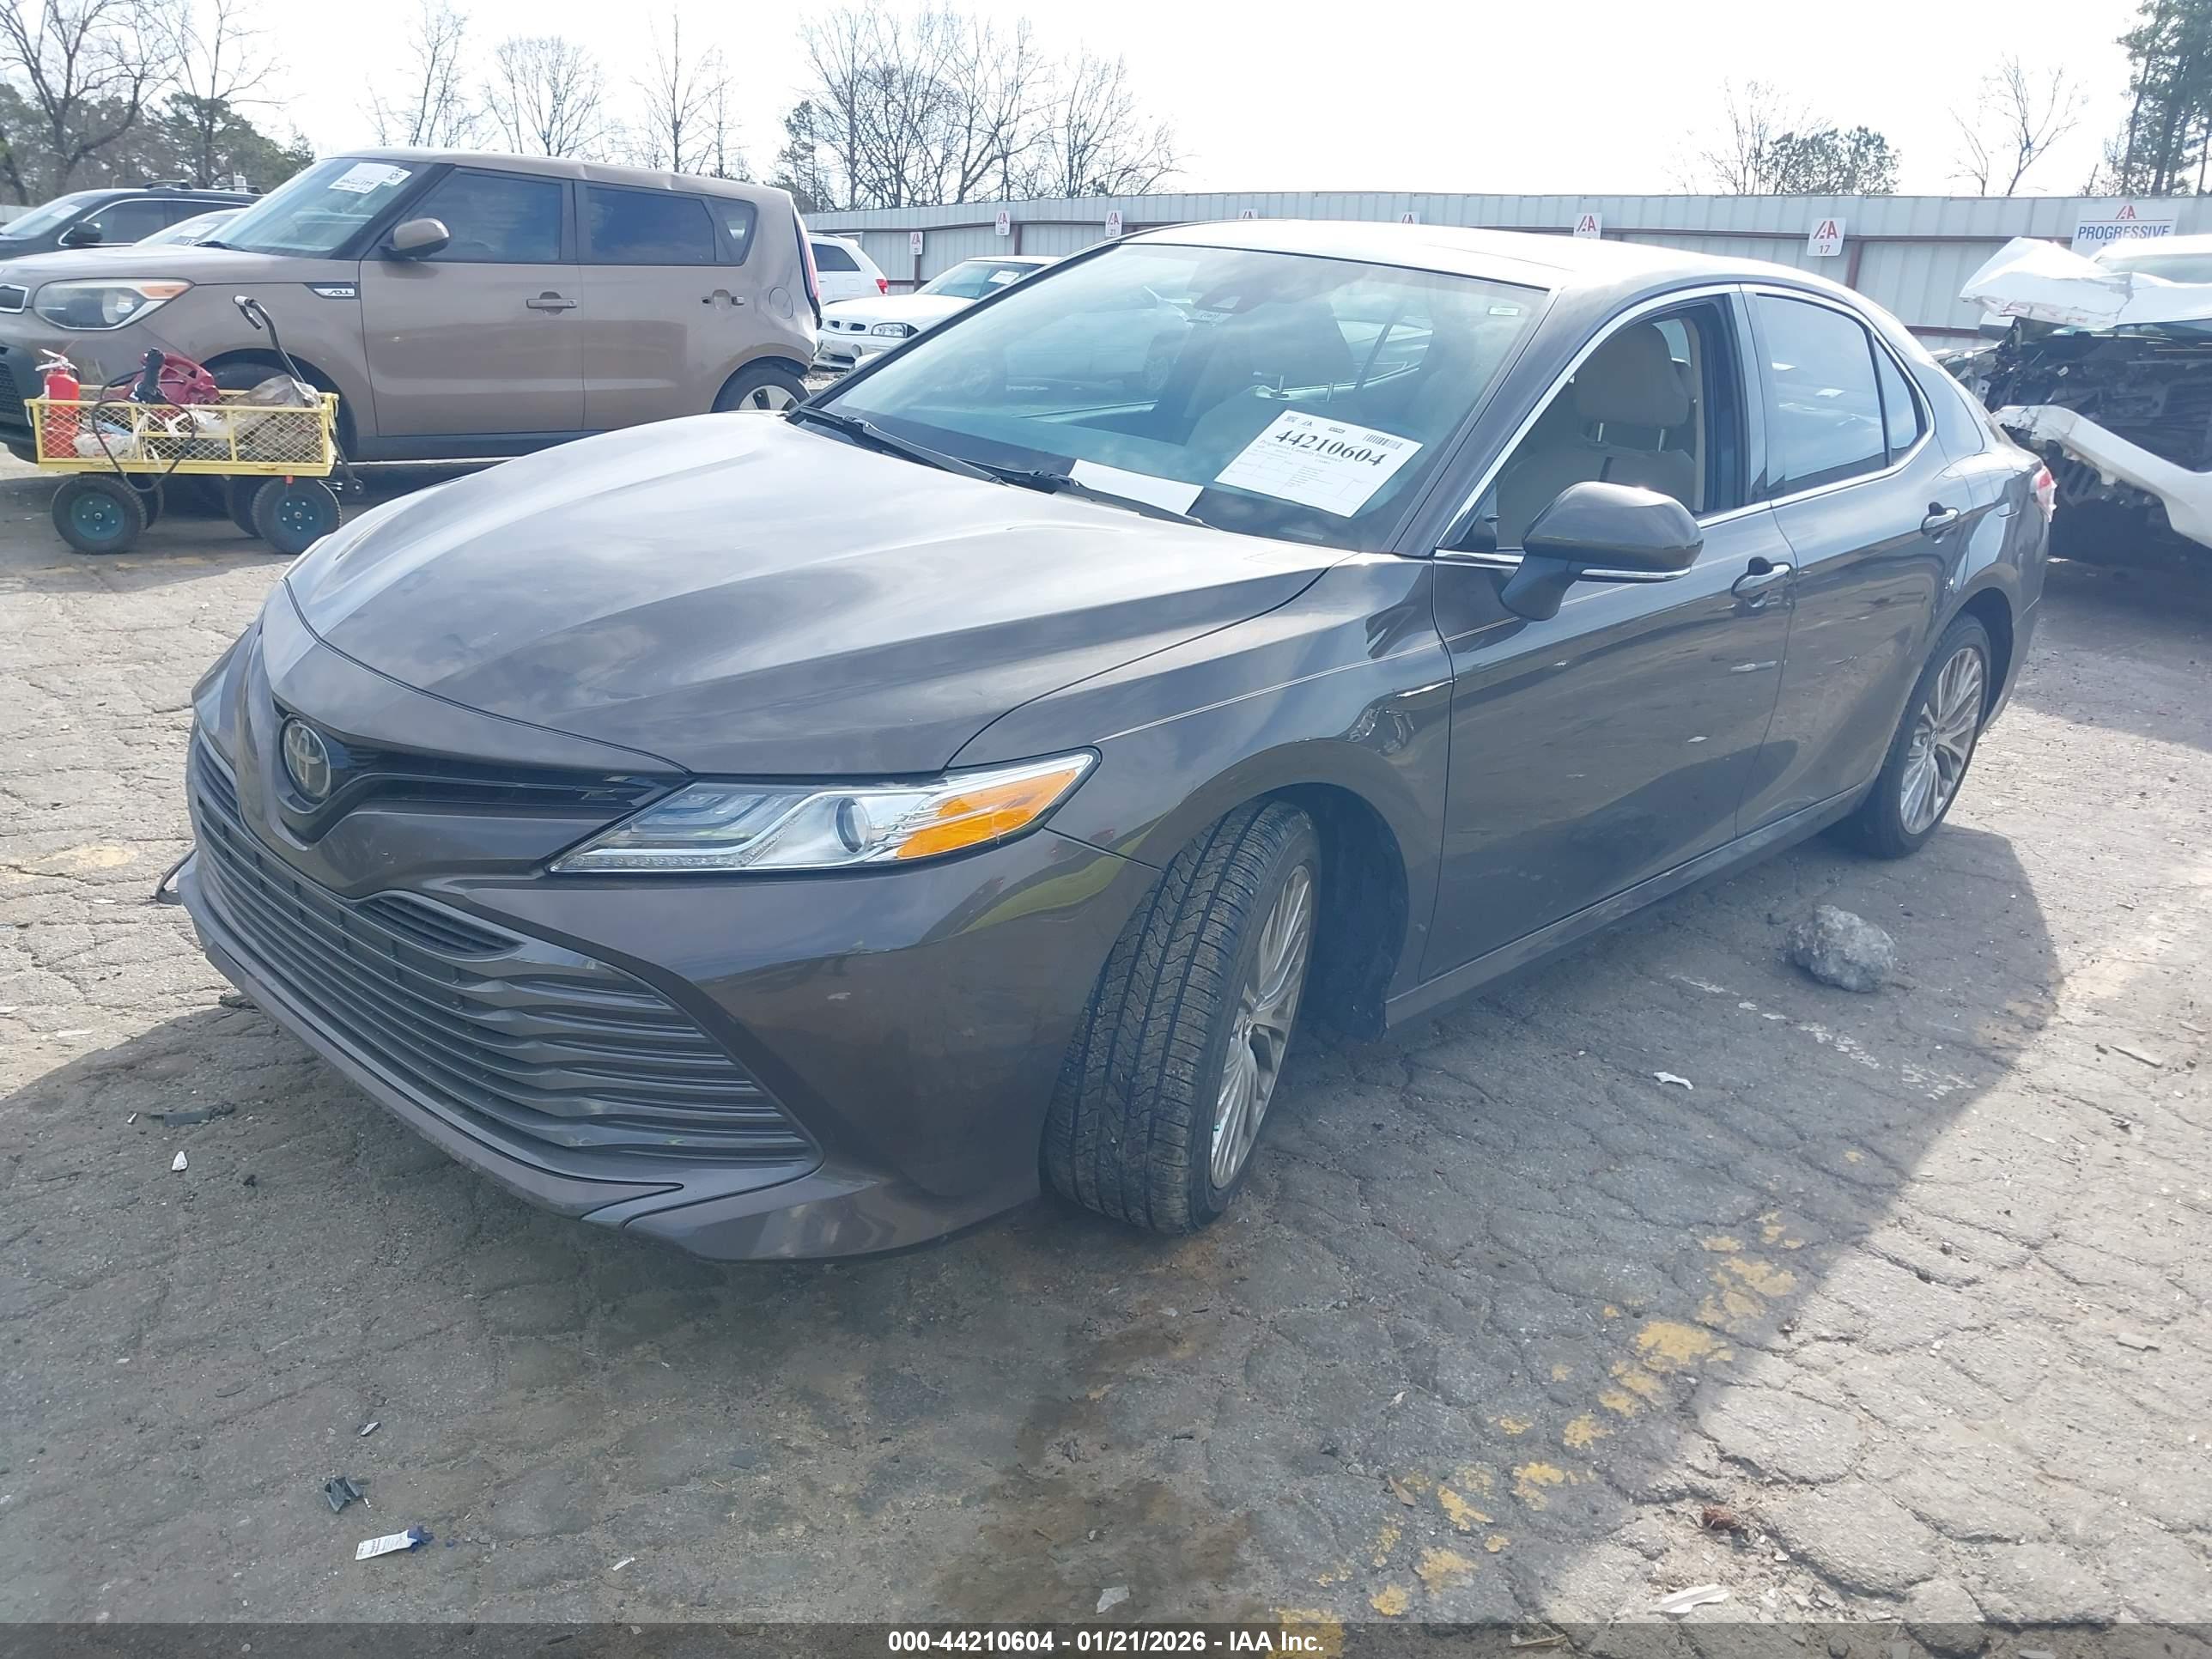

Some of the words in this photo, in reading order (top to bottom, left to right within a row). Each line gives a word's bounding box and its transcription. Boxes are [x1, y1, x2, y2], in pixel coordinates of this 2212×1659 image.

[2077, 225, 2172, 240] PROGRESSIVE
[1820, 244, 1831, 254] 17
[1274, 428, 1389, 466] 44210604
